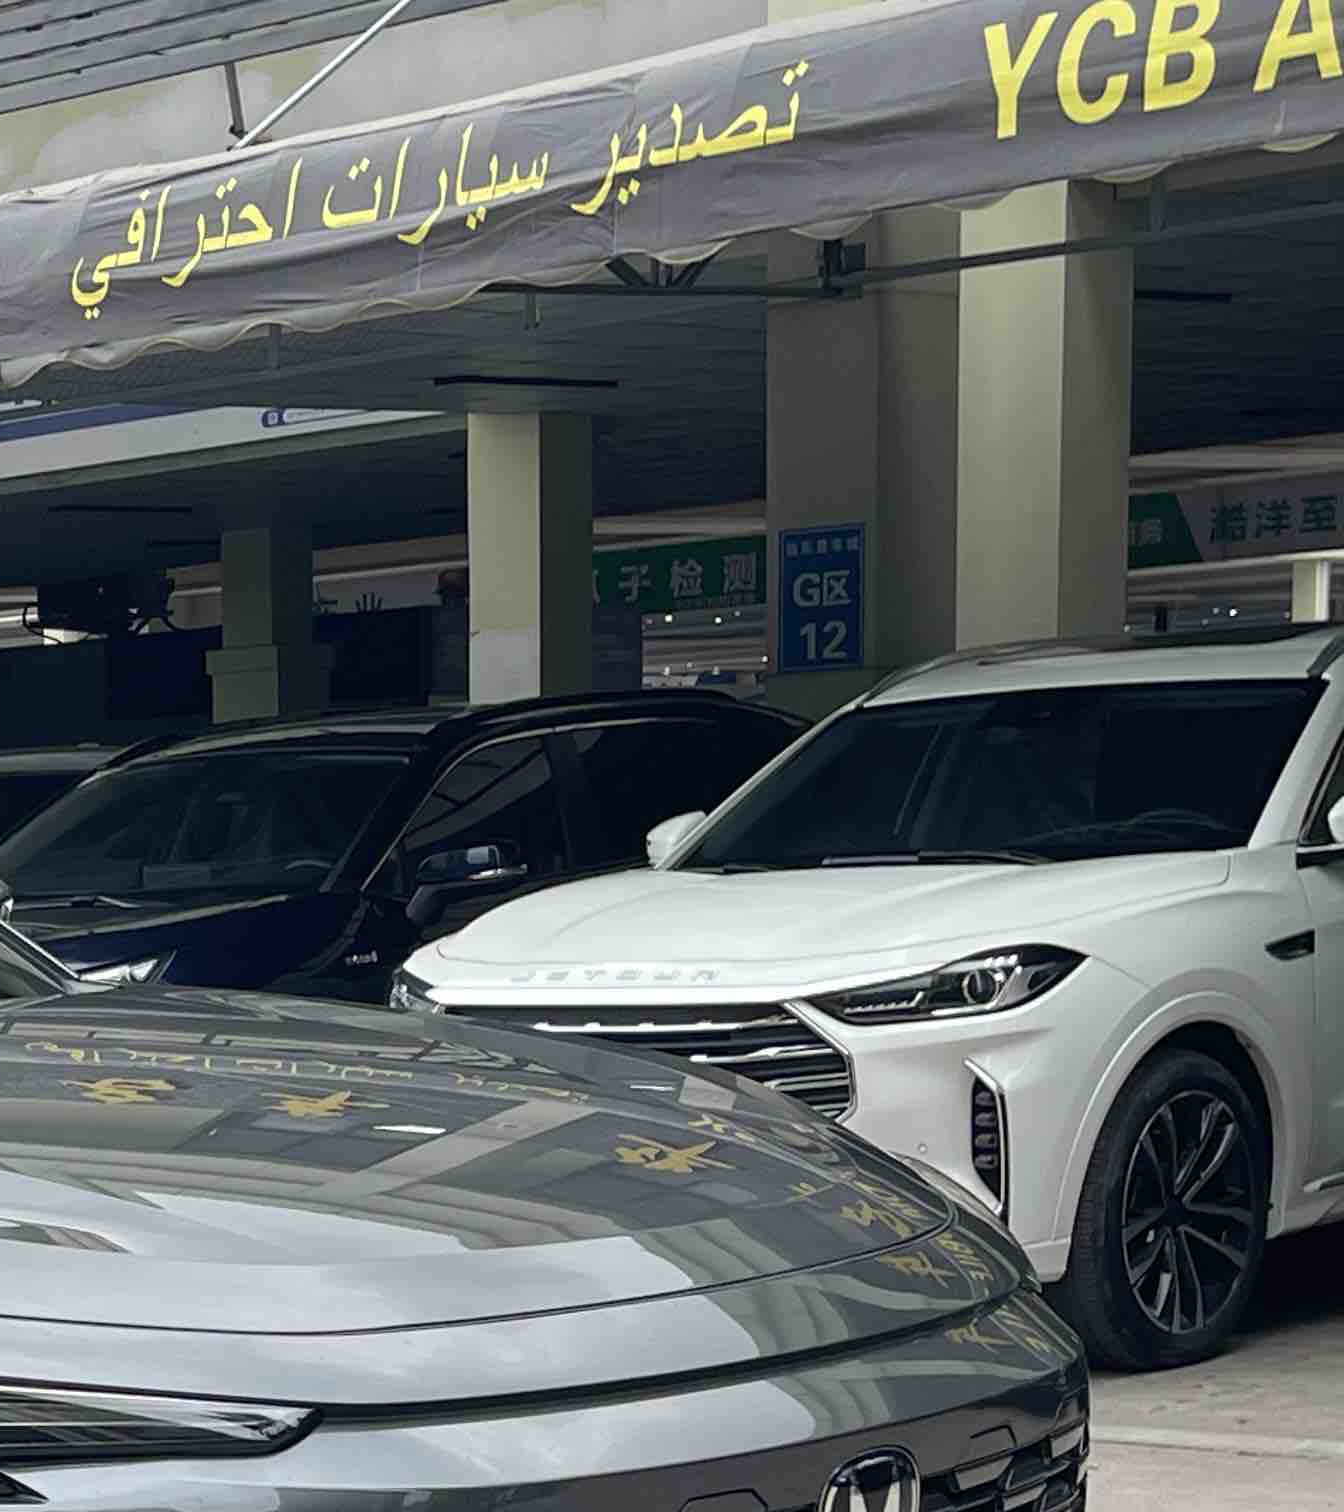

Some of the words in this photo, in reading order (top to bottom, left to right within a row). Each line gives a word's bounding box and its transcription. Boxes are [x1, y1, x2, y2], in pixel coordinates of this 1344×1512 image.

[983, 0, 1220, 140] YCB
[322, 124, 550, 246] سيارات
[572, 60, 809, 216] تصدير
[71, 157, 302, 320] احترافي
[793, 569, 852, 608] G区
[799, 620, 849, 661] 12
